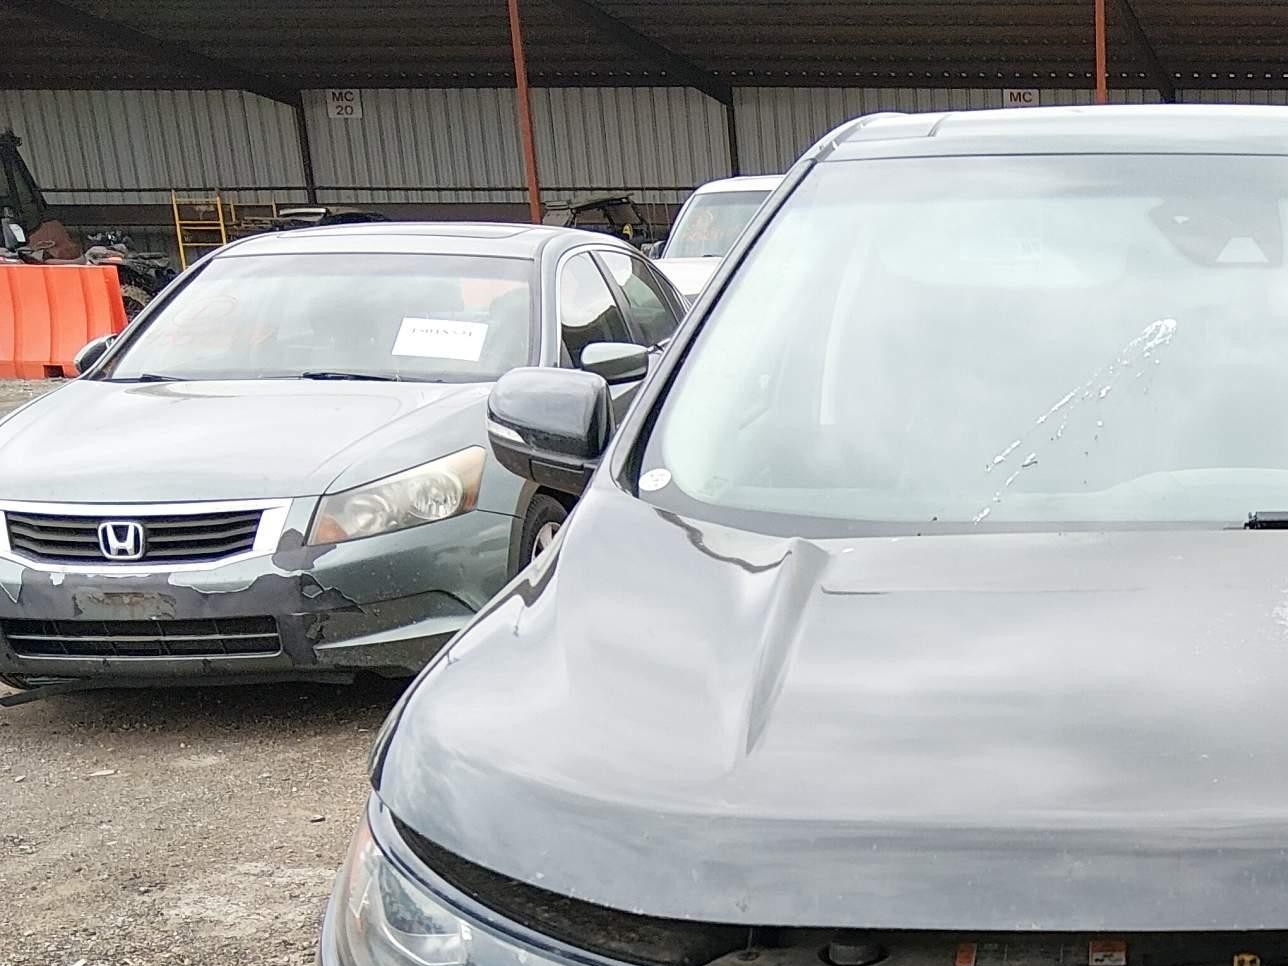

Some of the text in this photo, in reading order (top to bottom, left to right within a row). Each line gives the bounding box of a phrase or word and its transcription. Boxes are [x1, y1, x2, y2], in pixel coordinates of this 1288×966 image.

[331, 91, 354, 102] MC
[1010, 91, 1033, 103] MC
[336, 105, 354, 115] 20
